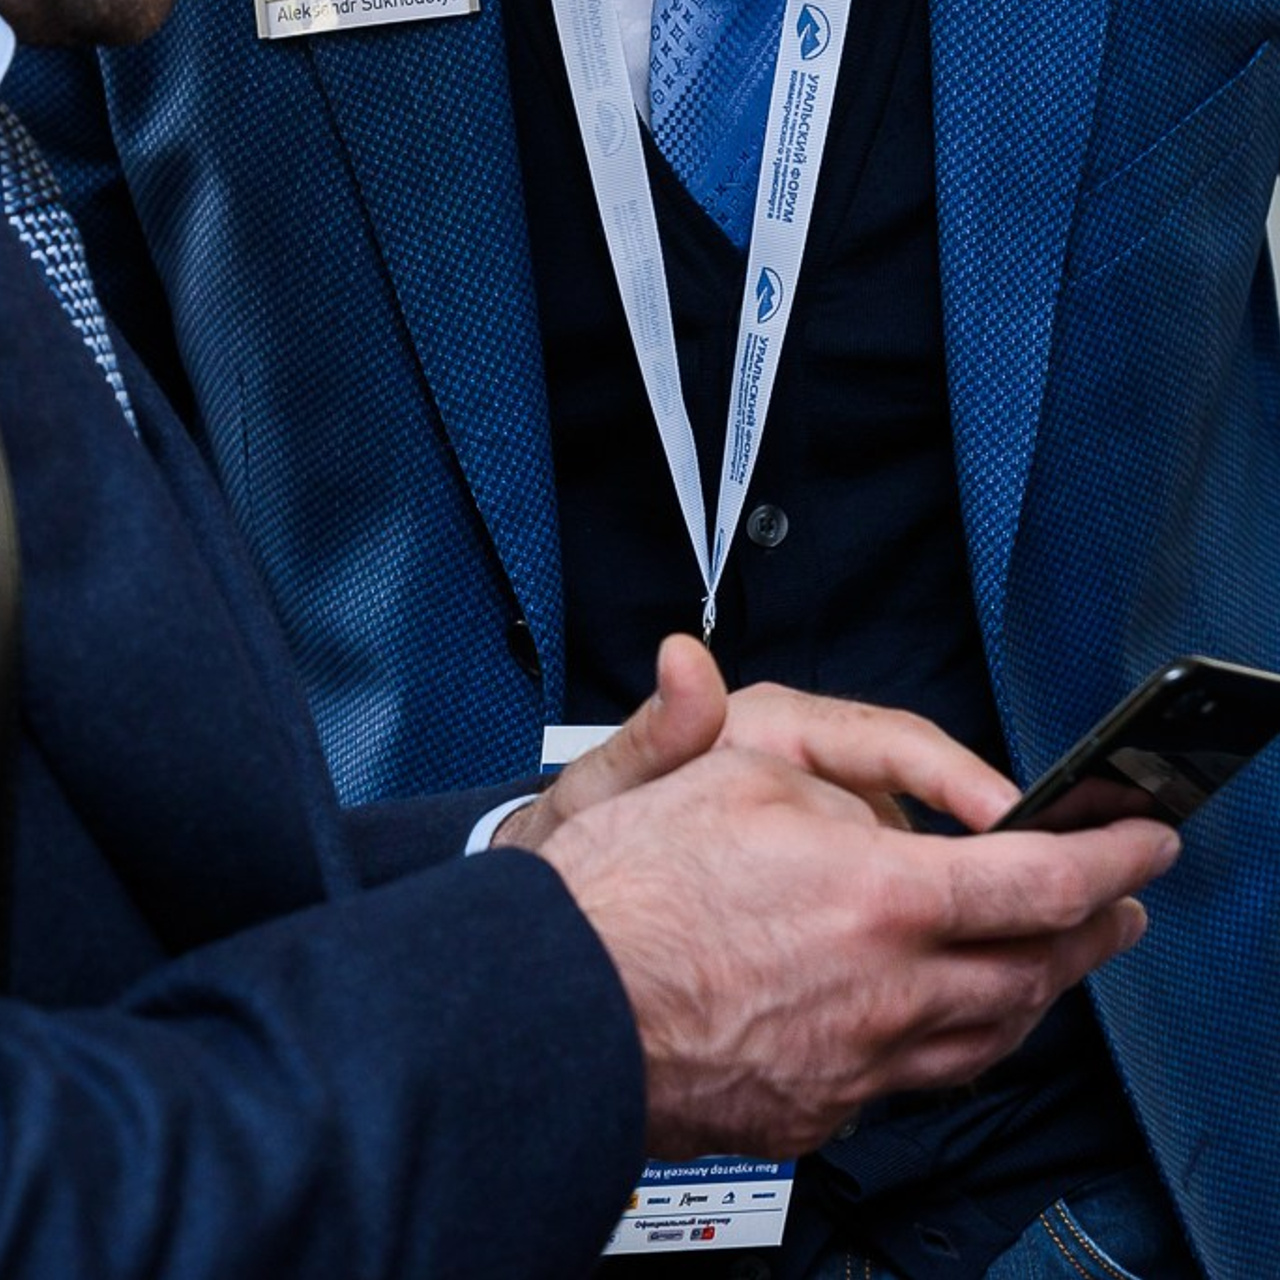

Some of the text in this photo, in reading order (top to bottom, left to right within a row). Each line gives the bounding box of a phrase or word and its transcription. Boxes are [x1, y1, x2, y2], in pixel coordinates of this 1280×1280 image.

[782, 73, 820, 224] УРАЛЬСКИЙ ФОРУМ
[746, 336, 769, 427] УРАЛЬСКИЙ
[641, 1163, 779, 1180] Ваш куратор Алексей Кор
